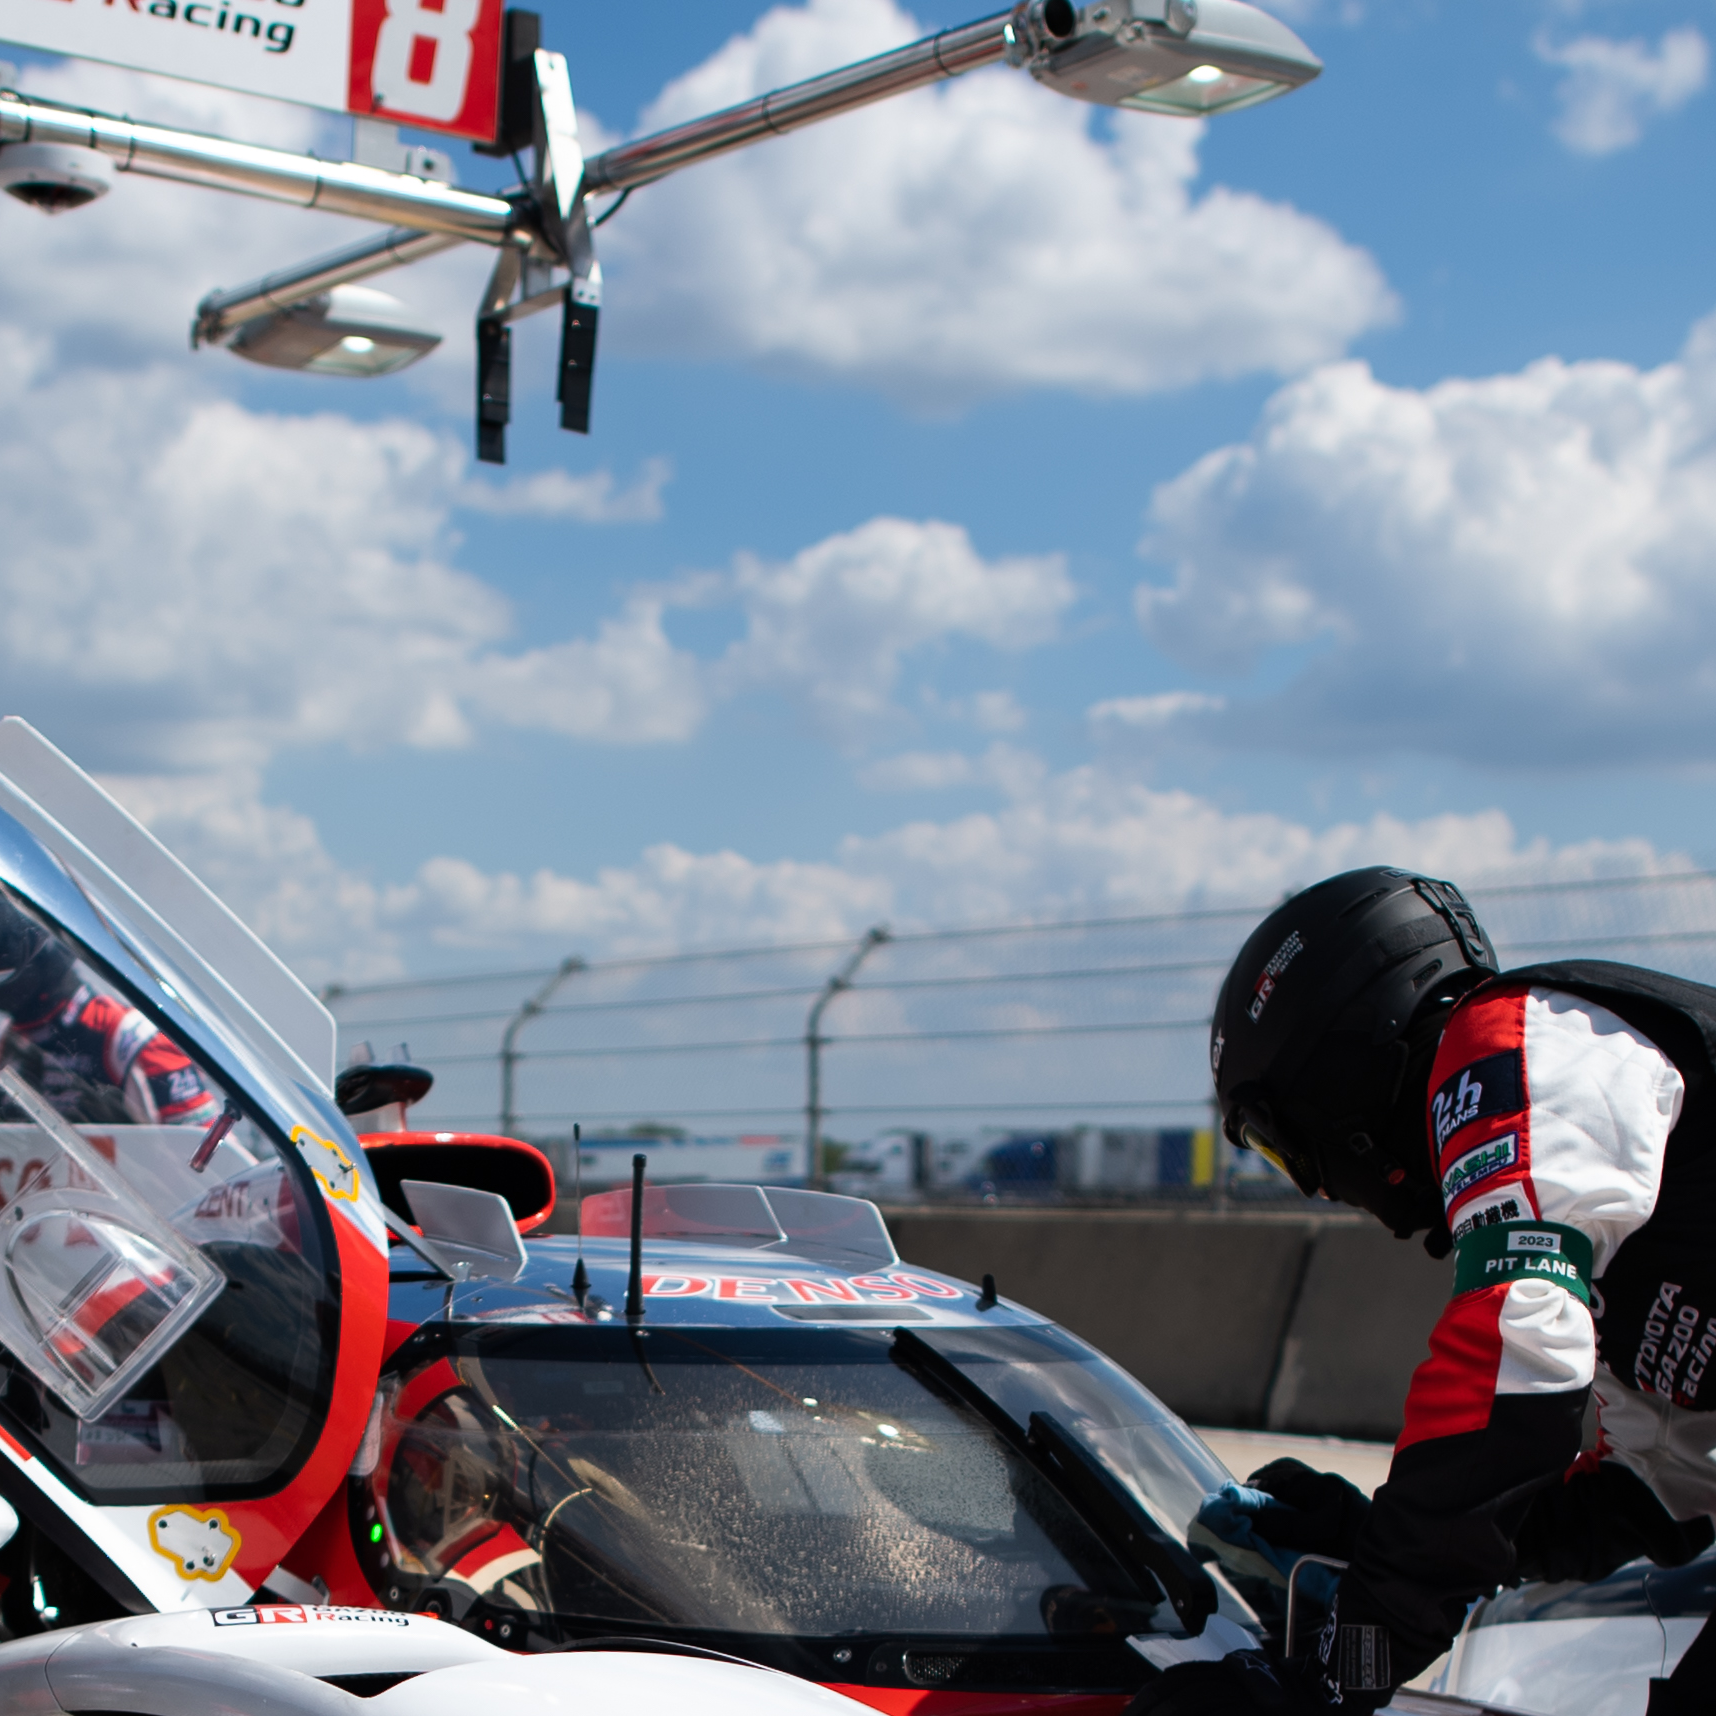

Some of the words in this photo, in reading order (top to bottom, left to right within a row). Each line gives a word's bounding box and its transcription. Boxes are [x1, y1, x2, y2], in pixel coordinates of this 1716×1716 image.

[371, 0, 476, 122] 8
[194, 1181, 250, 1219] ZENT
[1518, 1235, 1554, 1248] 2023
[1485, 1256, 1517, 1274] PIT
[1524, 1257, 1578, 1280] LANE
[638, 1273, 964, 1304] DENSO
[1634, 1281, 1683, 1380] TOYOTA
[1654, 1304, 1700, 1401] GAZOO
[214, 1606, 306, 1627] GR
[315, 1613, 410, 1627] Racing
